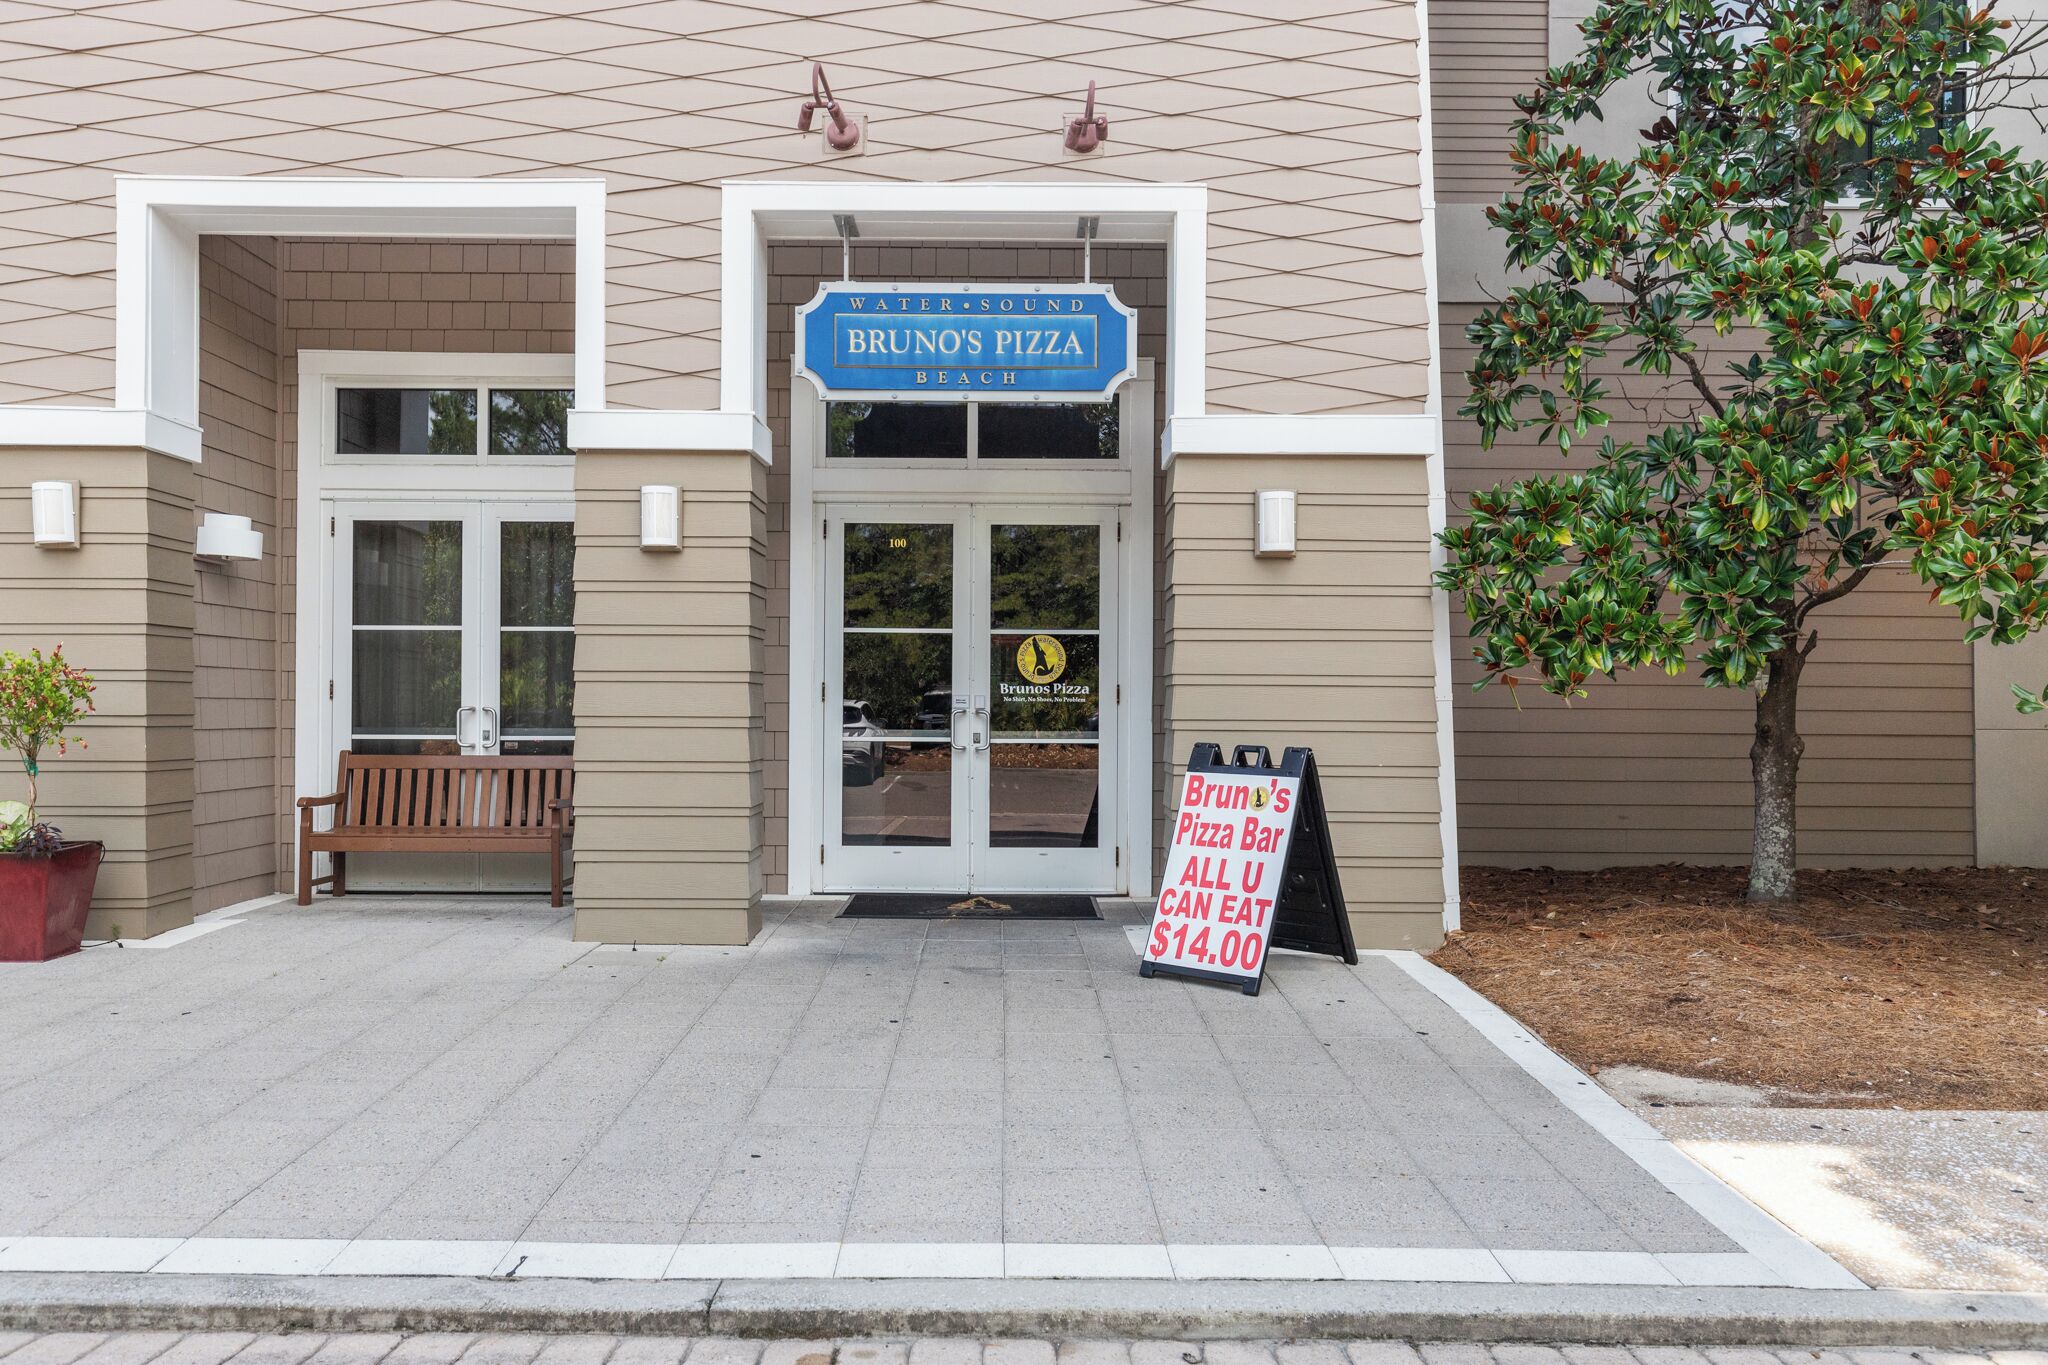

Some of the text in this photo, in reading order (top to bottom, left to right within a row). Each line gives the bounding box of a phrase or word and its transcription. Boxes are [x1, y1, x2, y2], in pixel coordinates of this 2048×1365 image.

[849, 298, 1085, 313] WATER SOUND
[847, 328, 1084, 355] BRUNO'S PIZZA
[915, 371, 1017, 385] BEACH
[889, 538, 907, 548] 100
[1000, 683, 1090, 695] Brunos Pizza
[1176, 812, 1284, 853] Pizza Bar
[1179, 855, 1265, 894] ALL U
[1159, 887, 1272, 928] CAN EAT
[1150, 919, 1263, 971] $14.00
